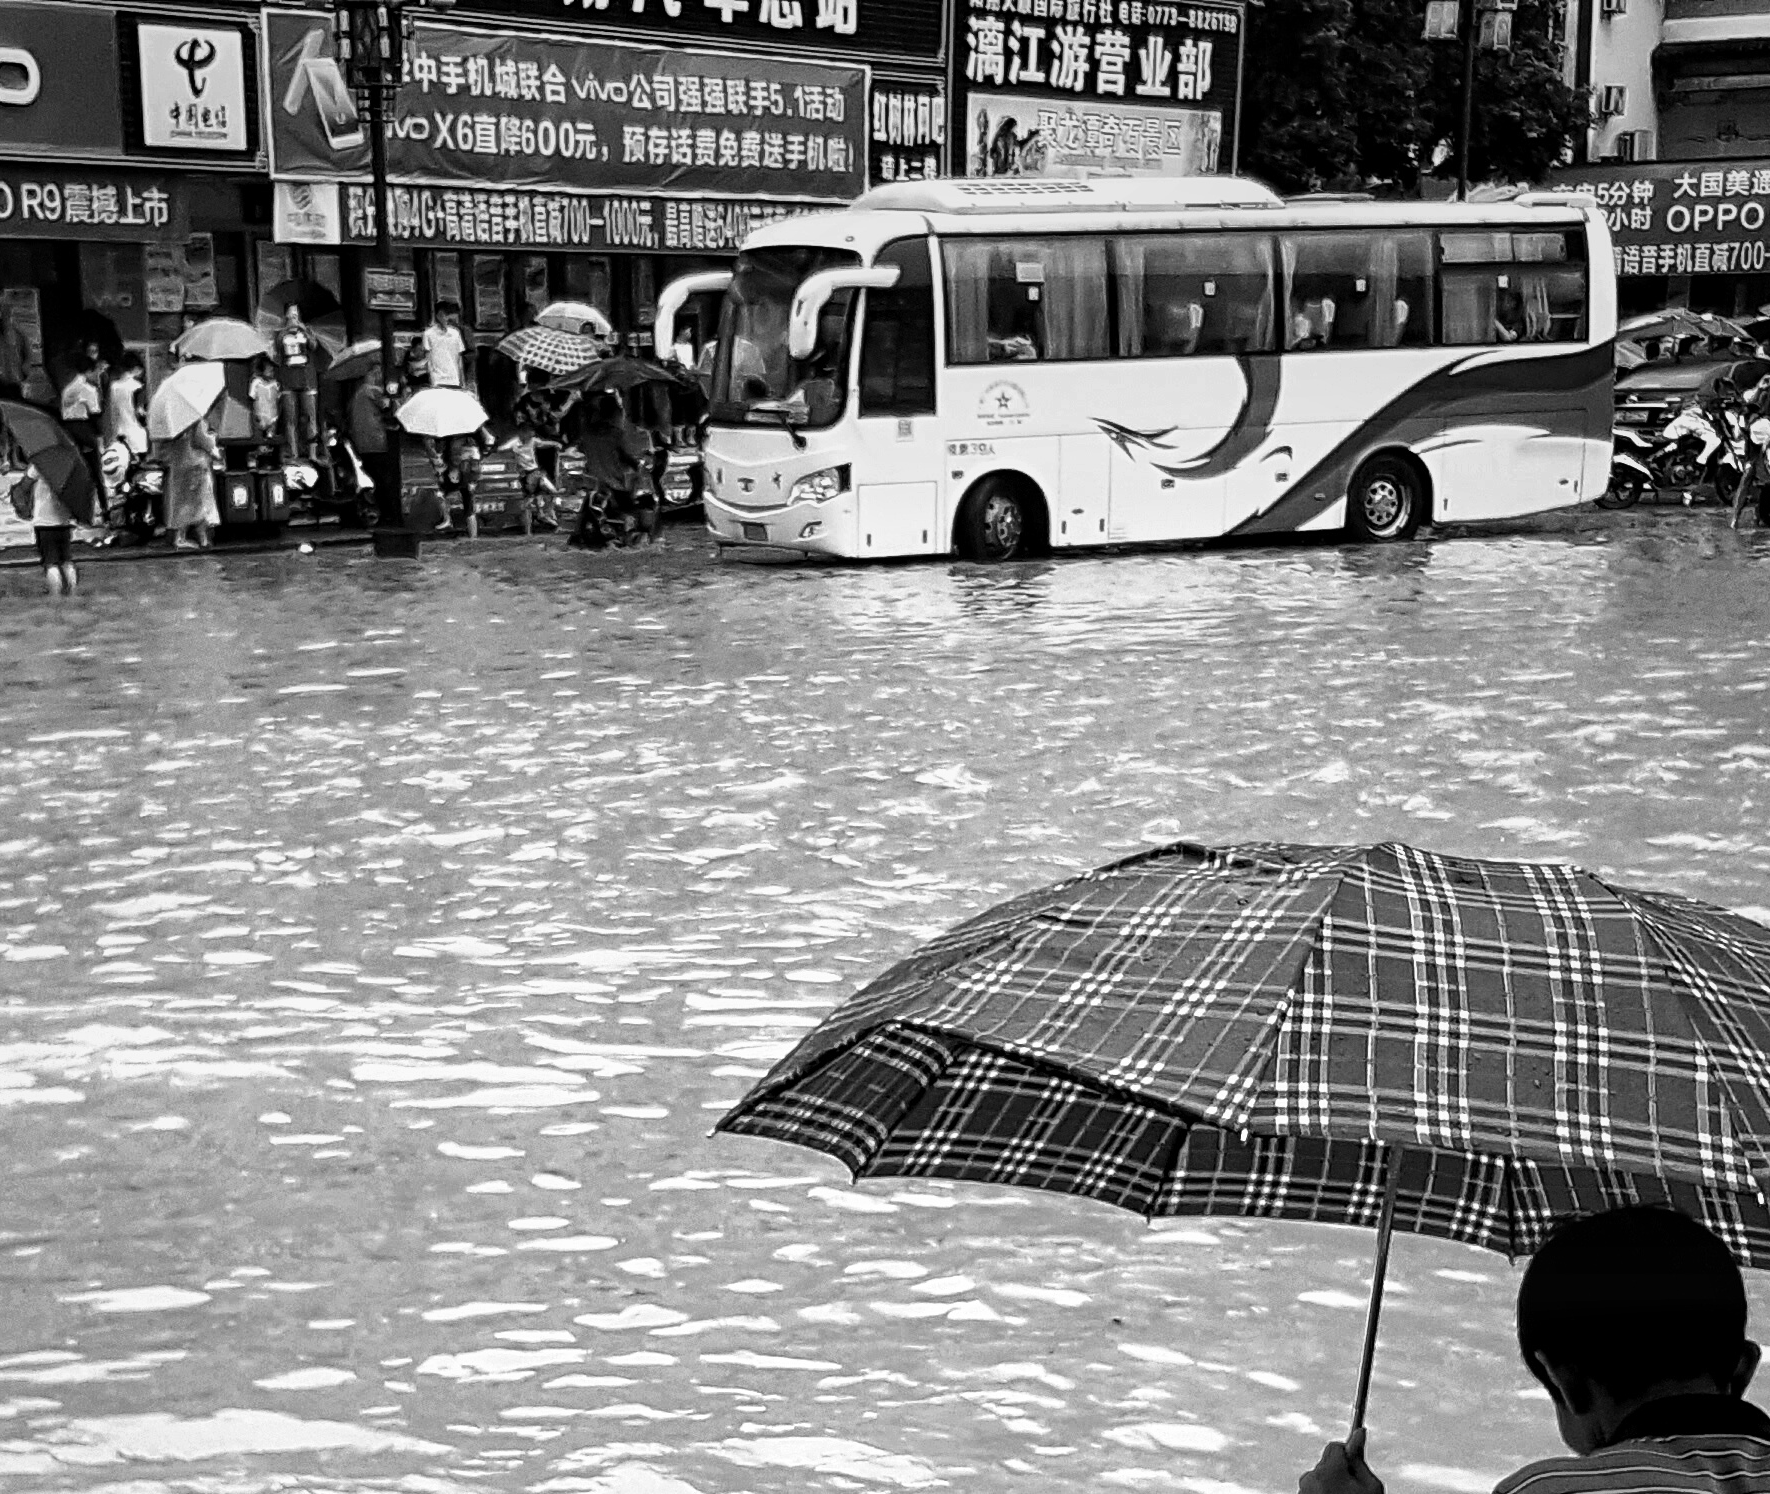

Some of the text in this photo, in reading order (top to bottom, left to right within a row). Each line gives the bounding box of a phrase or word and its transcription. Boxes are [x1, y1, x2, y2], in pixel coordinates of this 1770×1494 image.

[966, 15, 1213, 100] 漓江游营业部
[1667, 201, 1765, 232] OPPO
